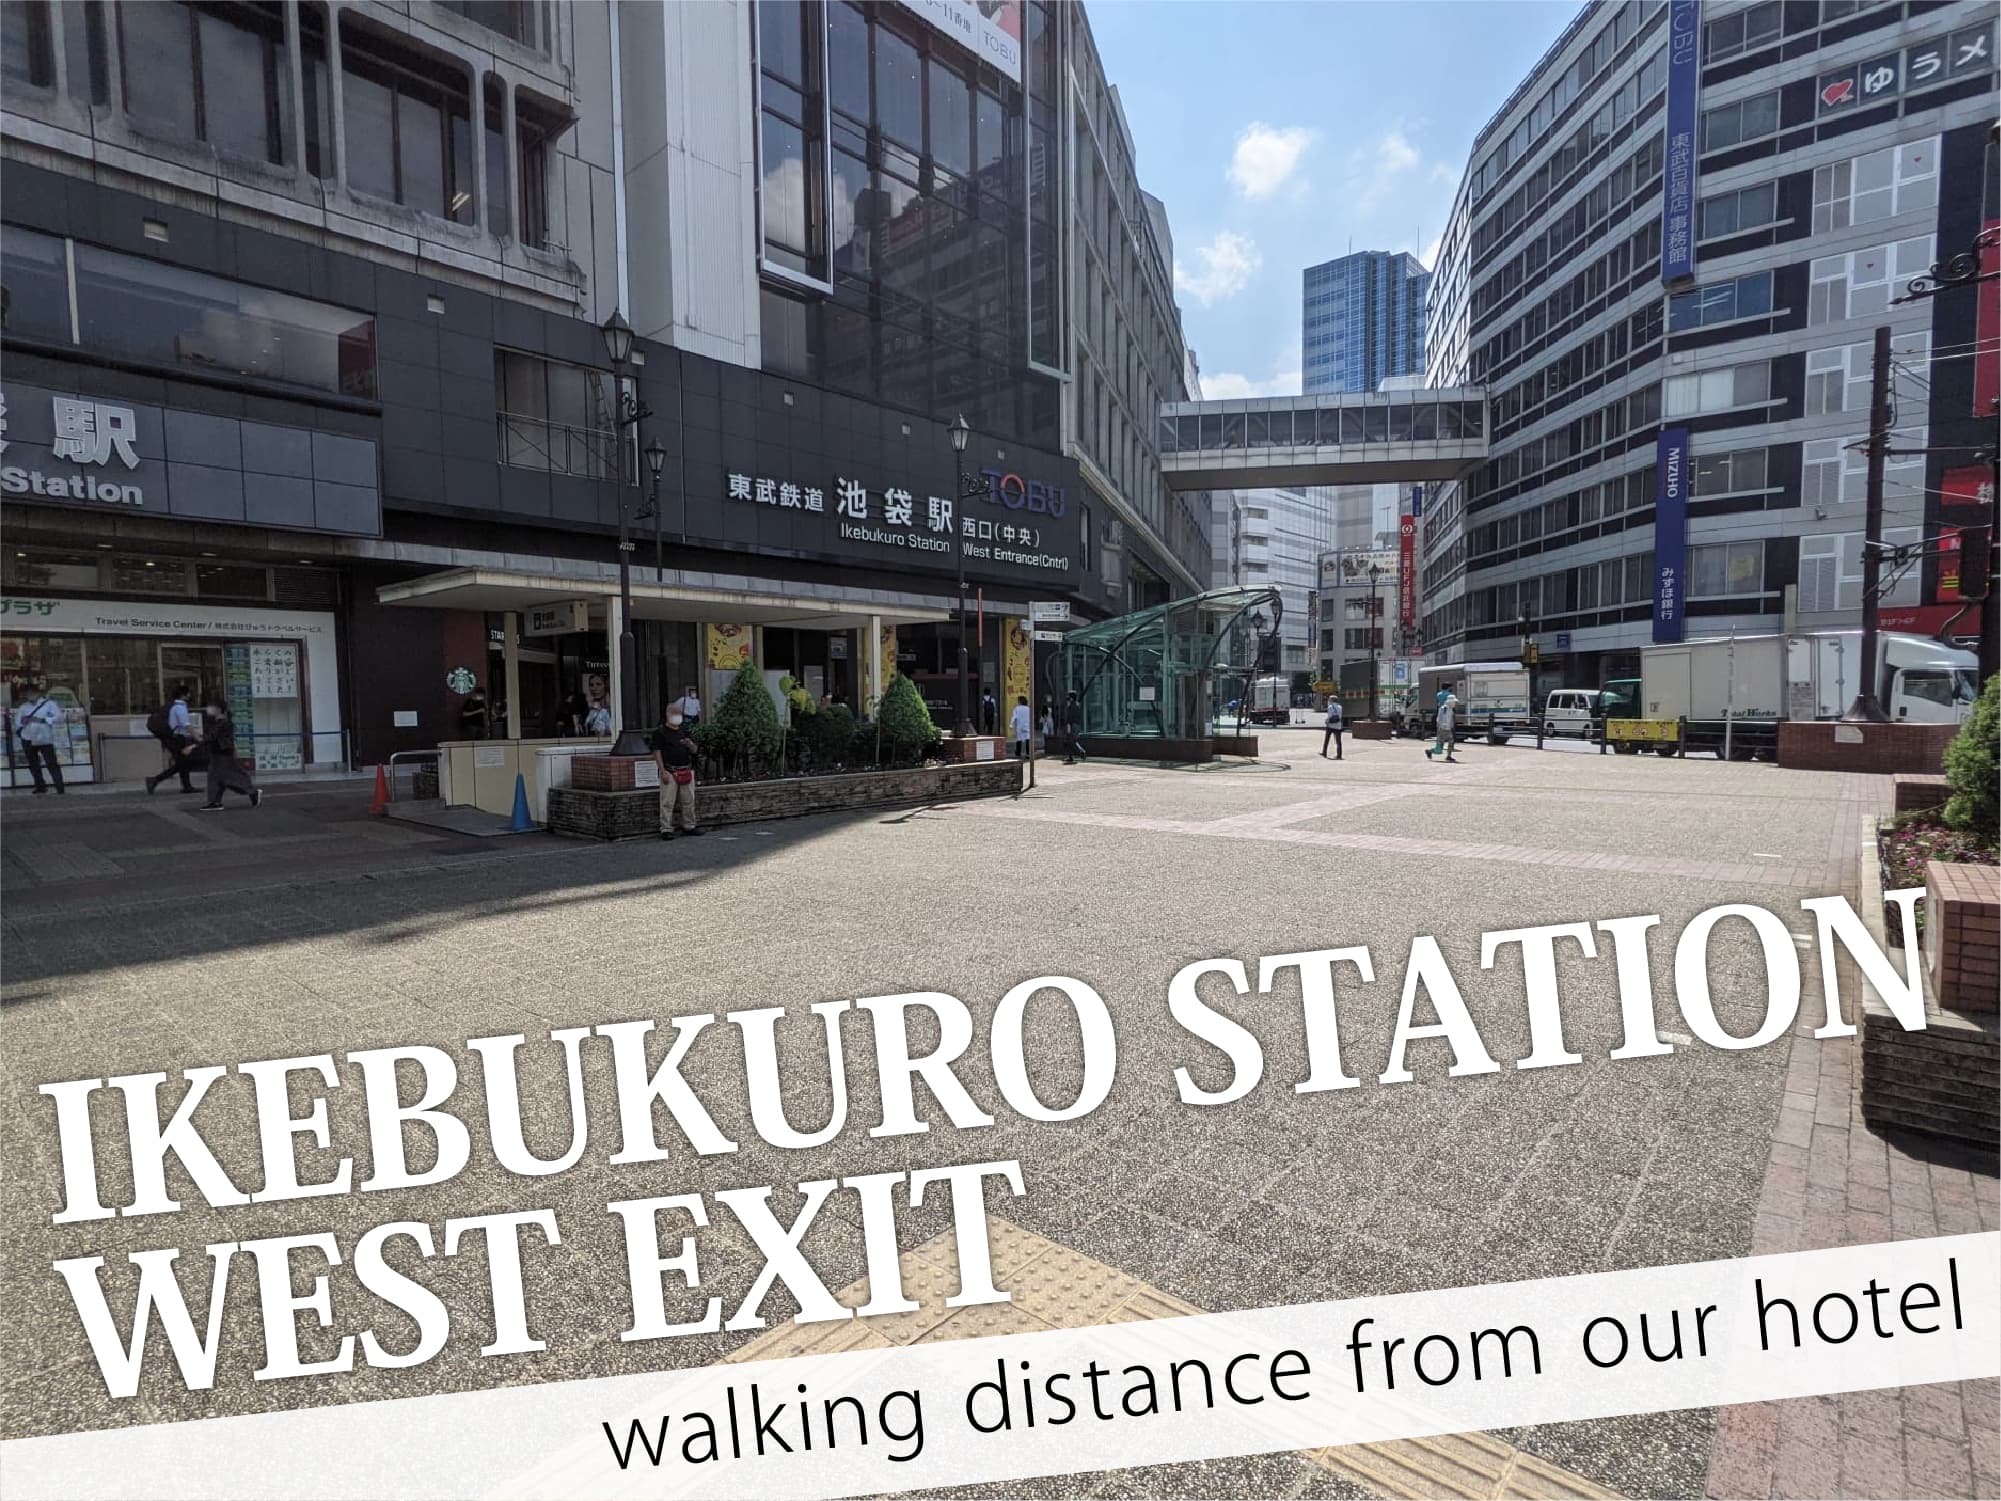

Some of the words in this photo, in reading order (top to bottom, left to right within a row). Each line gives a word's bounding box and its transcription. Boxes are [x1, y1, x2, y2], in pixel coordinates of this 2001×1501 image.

[984, 32, 1016, 64] TOBU
[0, 466, 143, 505] Station
[981, 470, 1065, 518] TOBU
[1667, 447, 1680, 498] MIZUHO
[728, 473, 825, 513] 東武鉄道
[837, 477, 954, 534] 池袋駅
[840, 522, 905, 546] Ikebukuro
[908, 533, 951, 553] Station
[962, 541, 991, 559] West
[1661, 567, 1674, 620] みずほ銀行
[96, 616, 129, 627] Travel
[131, 617, 171, 628] Service
